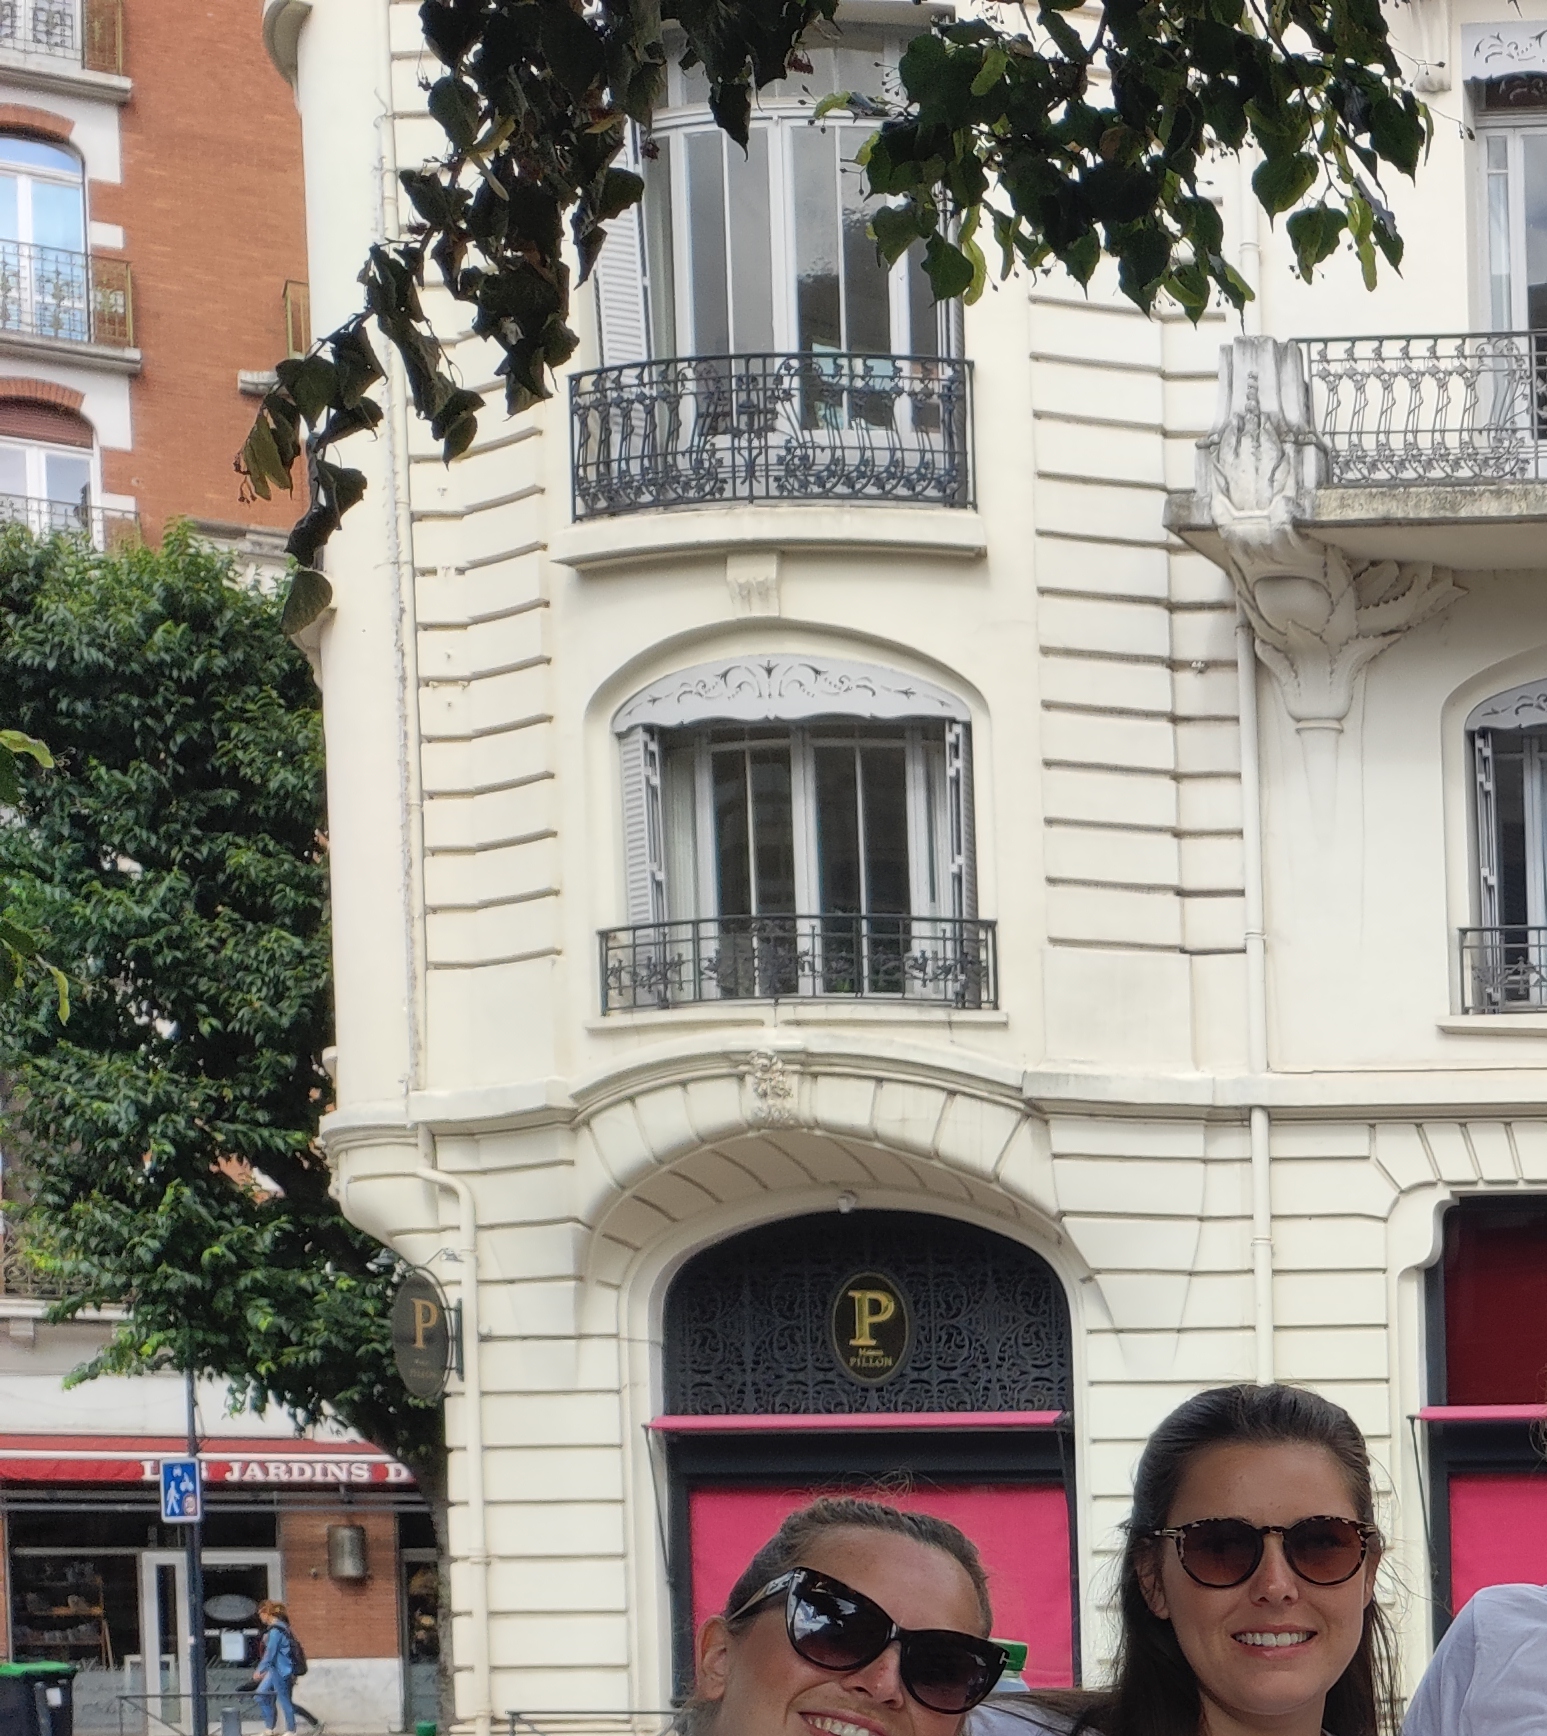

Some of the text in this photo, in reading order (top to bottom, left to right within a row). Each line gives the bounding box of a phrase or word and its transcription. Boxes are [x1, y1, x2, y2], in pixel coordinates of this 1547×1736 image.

[411, 1298, 438, 1350] P
[848, 1290, 895, 1346] P
[849, 1357, 893, 1367] PILLON
[225, 1461, 368, 1481] JARDINS
